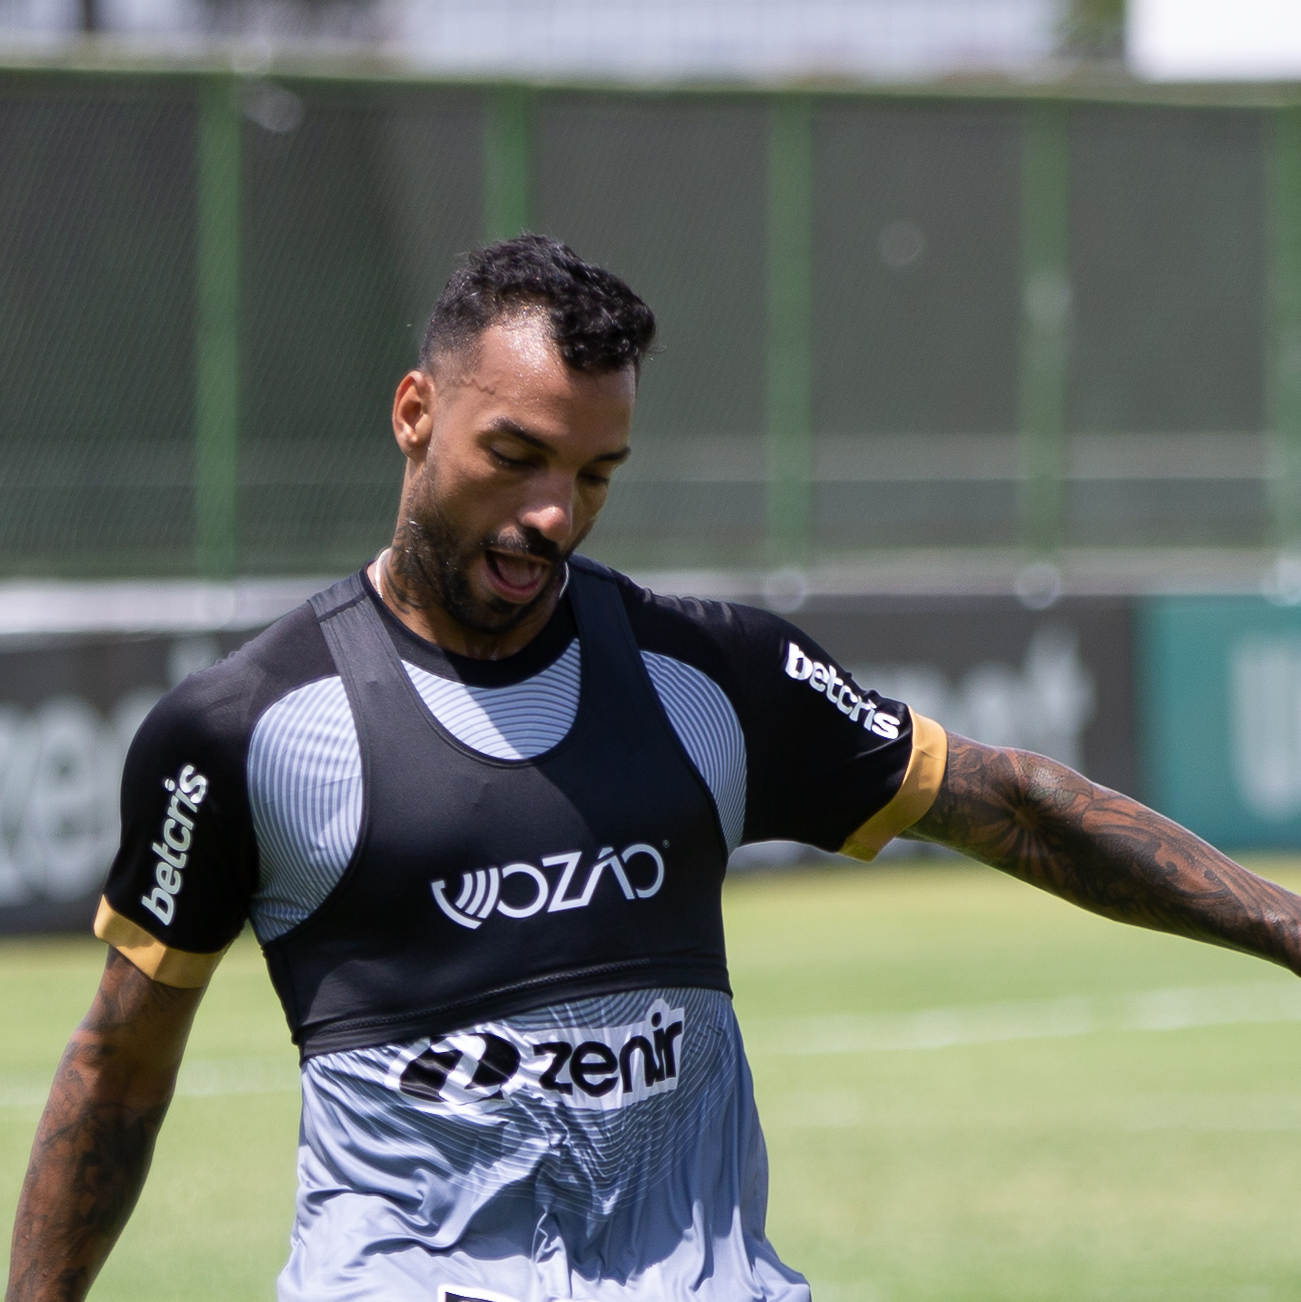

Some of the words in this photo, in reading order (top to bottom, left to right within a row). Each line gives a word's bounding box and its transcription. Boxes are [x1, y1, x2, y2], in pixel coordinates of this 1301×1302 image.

[785, 642, 900, 739] betcris
[141, 764, 209, 926] betcris
[532, 1011, 683, 1097] zenir
